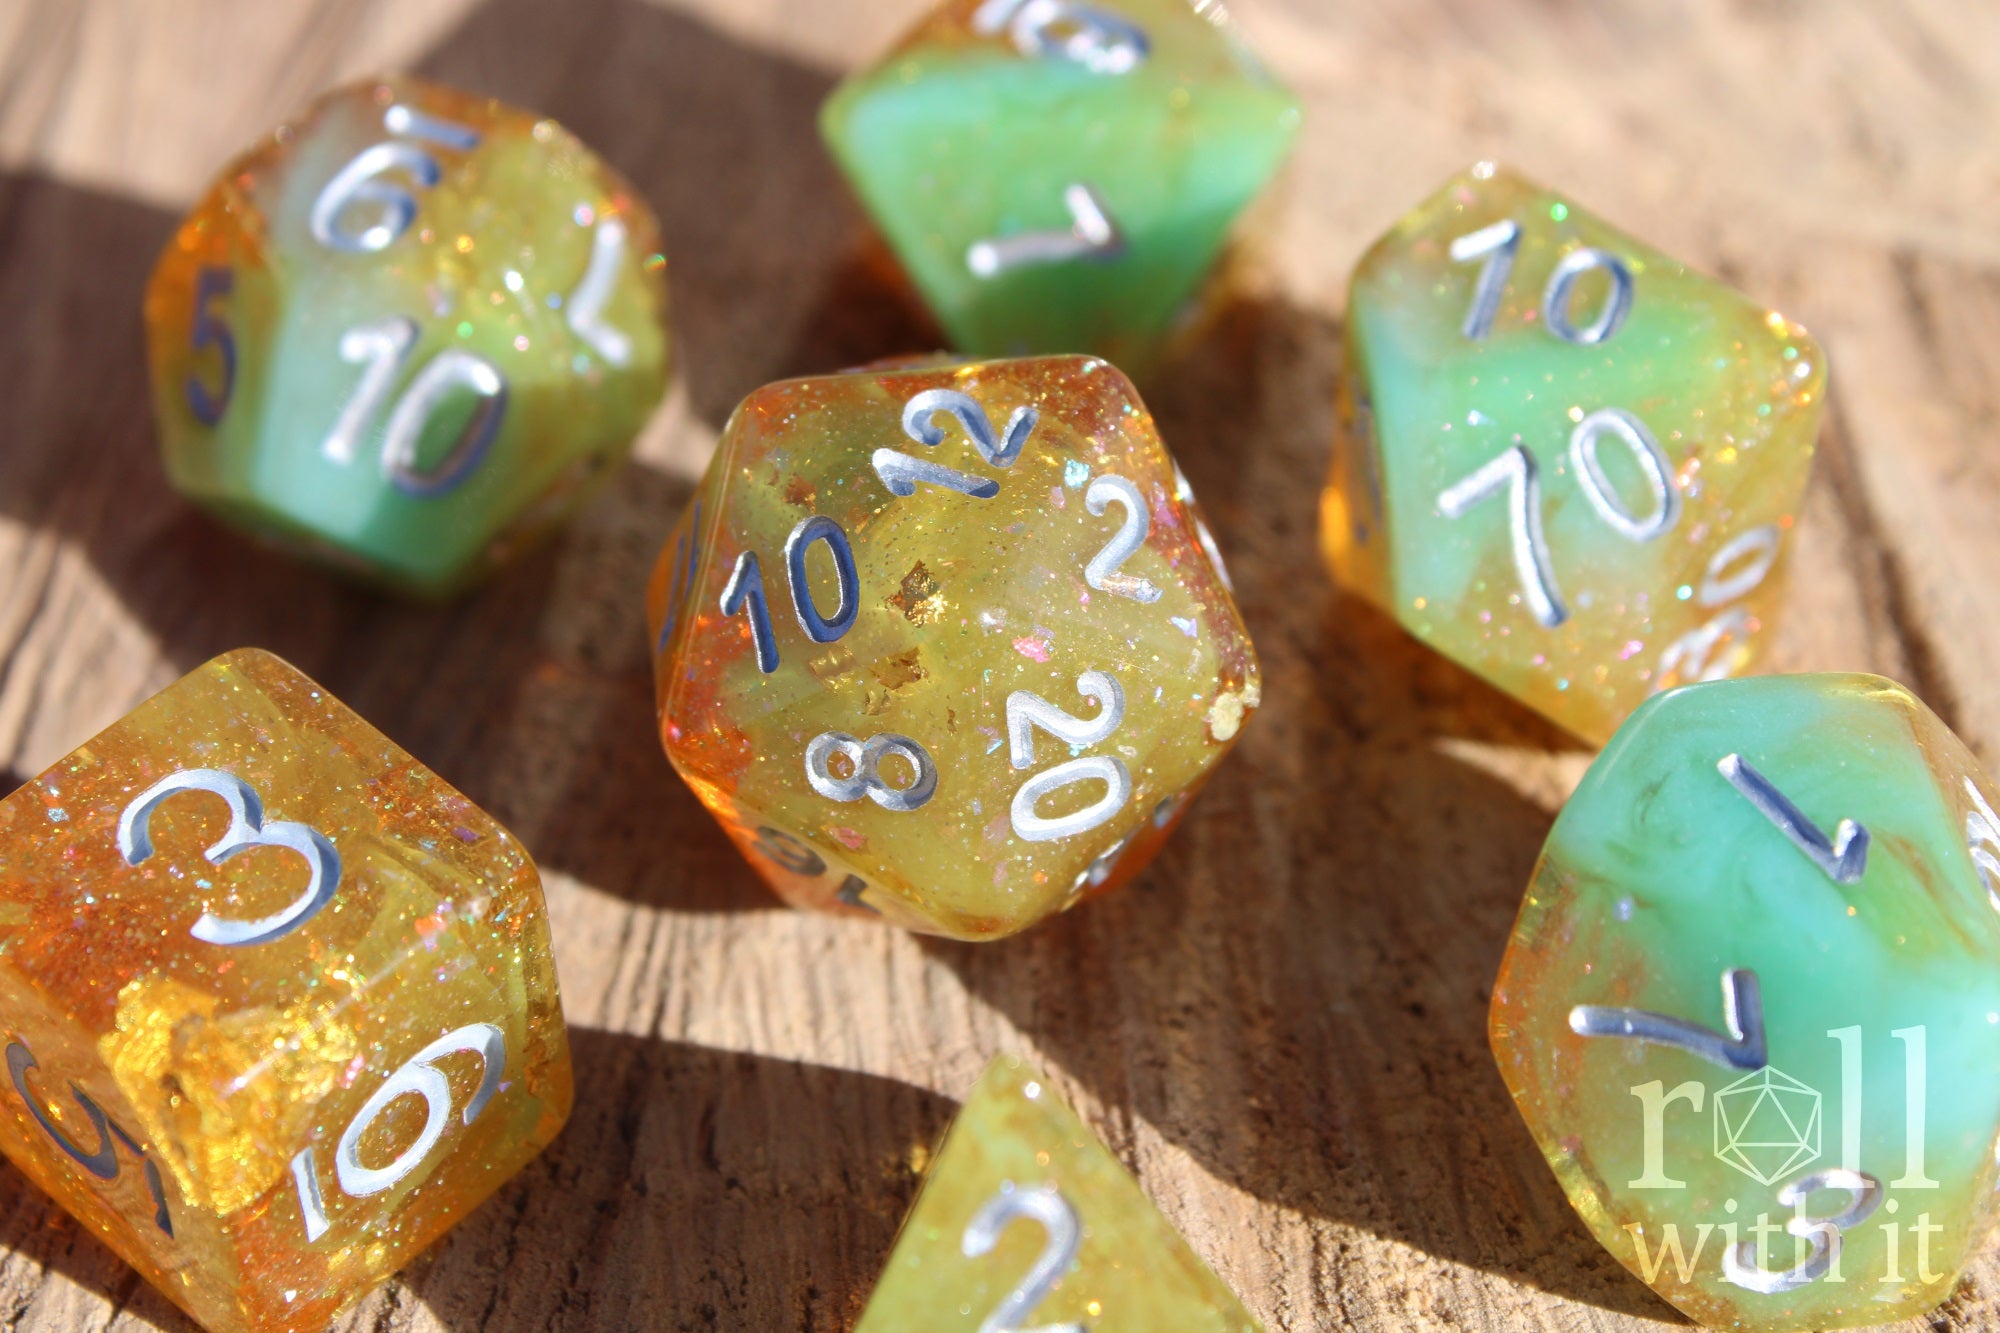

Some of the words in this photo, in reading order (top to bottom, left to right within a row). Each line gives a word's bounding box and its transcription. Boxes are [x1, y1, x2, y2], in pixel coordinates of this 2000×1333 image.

[186, 266, 237, 428] 5
[1449, 219, 1634, 345] 10
[321, 317, 509, 496] 10
[872, 388, 1038, 499] 12
[720, 515, 861, 674] 10
[1085, 474, 1163, 603] 2
[805, 730, 939, 812] 8
[1006, 670, 1133, 842] 20
[117, 768, 343, 947] 3
[961, 1184, 1088, 1333] 2
